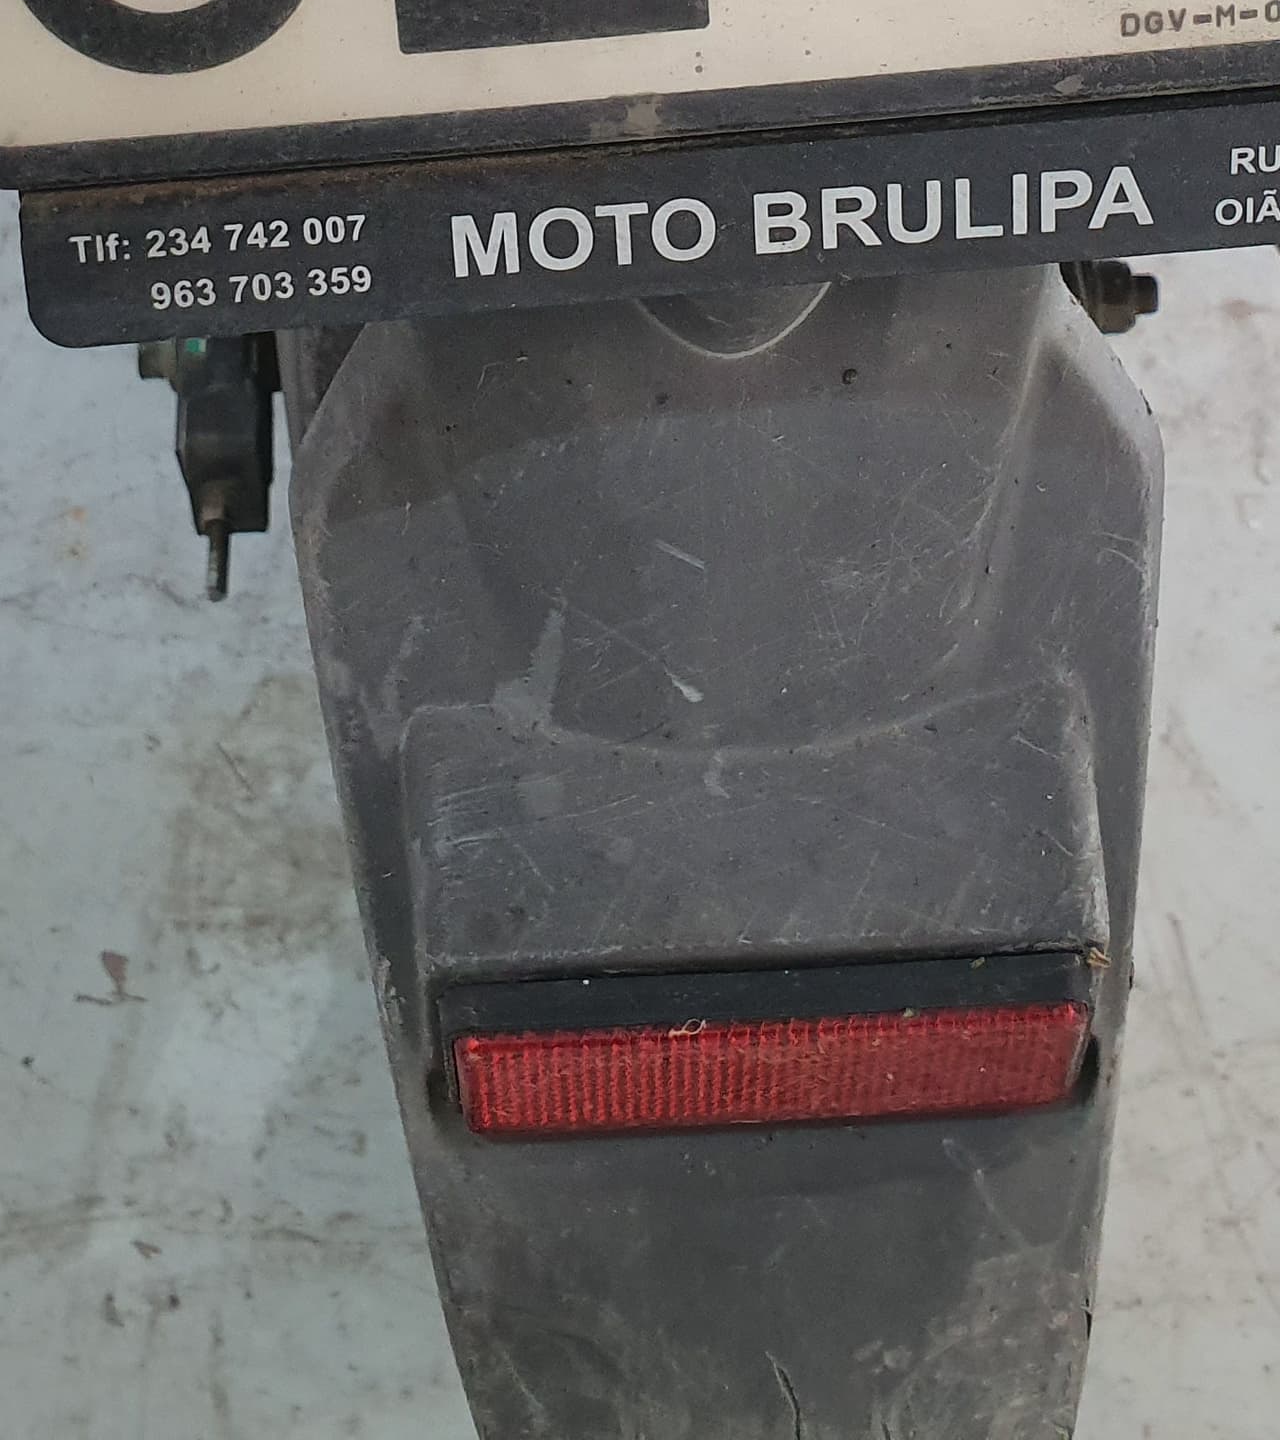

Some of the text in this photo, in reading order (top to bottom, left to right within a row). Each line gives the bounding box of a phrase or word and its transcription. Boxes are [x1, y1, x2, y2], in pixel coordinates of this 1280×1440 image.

[69, 214, 366, 263] Tlf: 234 742 007
[451, 165, 1154, 278] MOTO BRULIPA
[151, 265, 372, 310] 963 703 359
